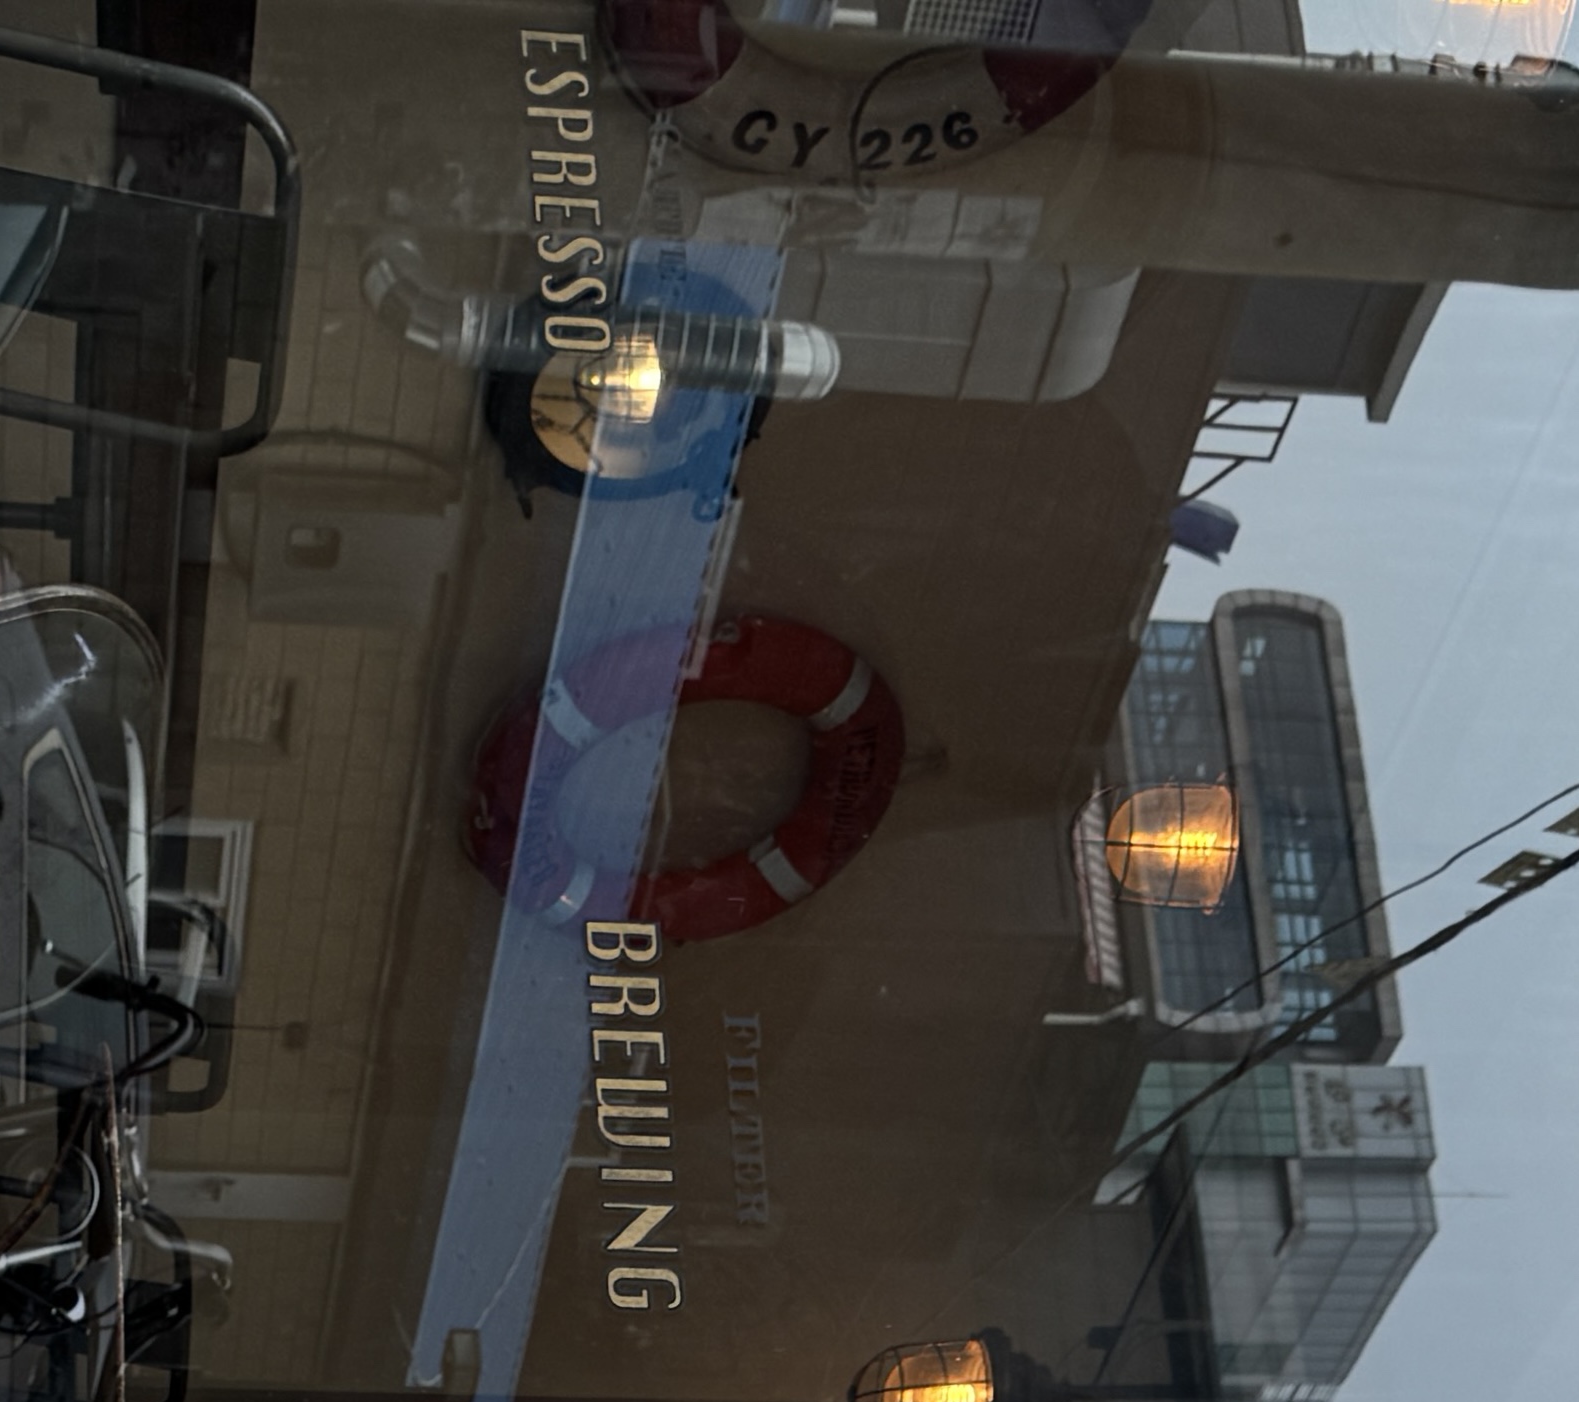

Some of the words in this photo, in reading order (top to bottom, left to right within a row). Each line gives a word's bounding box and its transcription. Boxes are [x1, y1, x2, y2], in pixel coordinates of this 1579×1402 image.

[520, 28, 612, 352] ESPRESSO
[732, 110, 831, 168] CY
[859, 112, 979, 171] 226
[584, 921, 682, 1311] BREWING
[722, 1009, 770, 1225] FILTER
